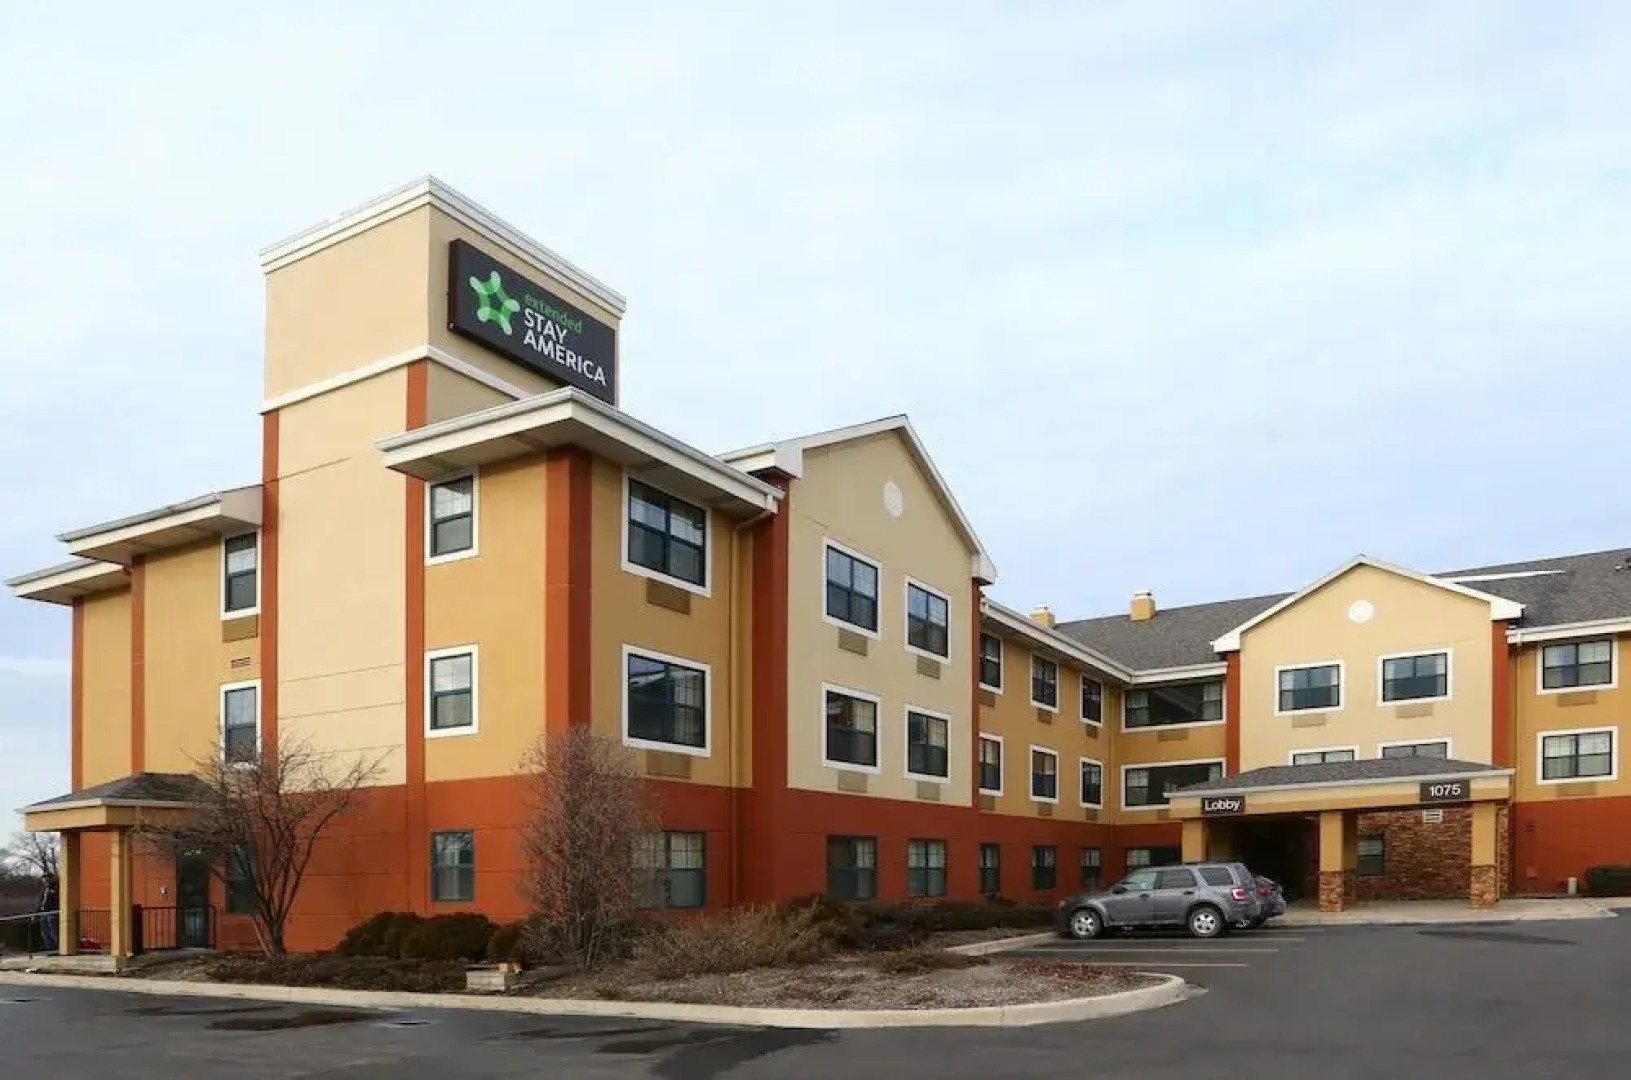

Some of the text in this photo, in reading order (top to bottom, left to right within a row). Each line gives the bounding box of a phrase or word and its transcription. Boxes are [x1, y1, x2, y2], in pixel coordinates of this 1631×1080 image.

[524, 307, 567, 344] STAY
[525, 294, 582, 334] extended
[523, 329, 606, 386] AMERICA
[1204, 798, 1241, 812] Lobby
[1429, 784, 1461, 797] 1075
